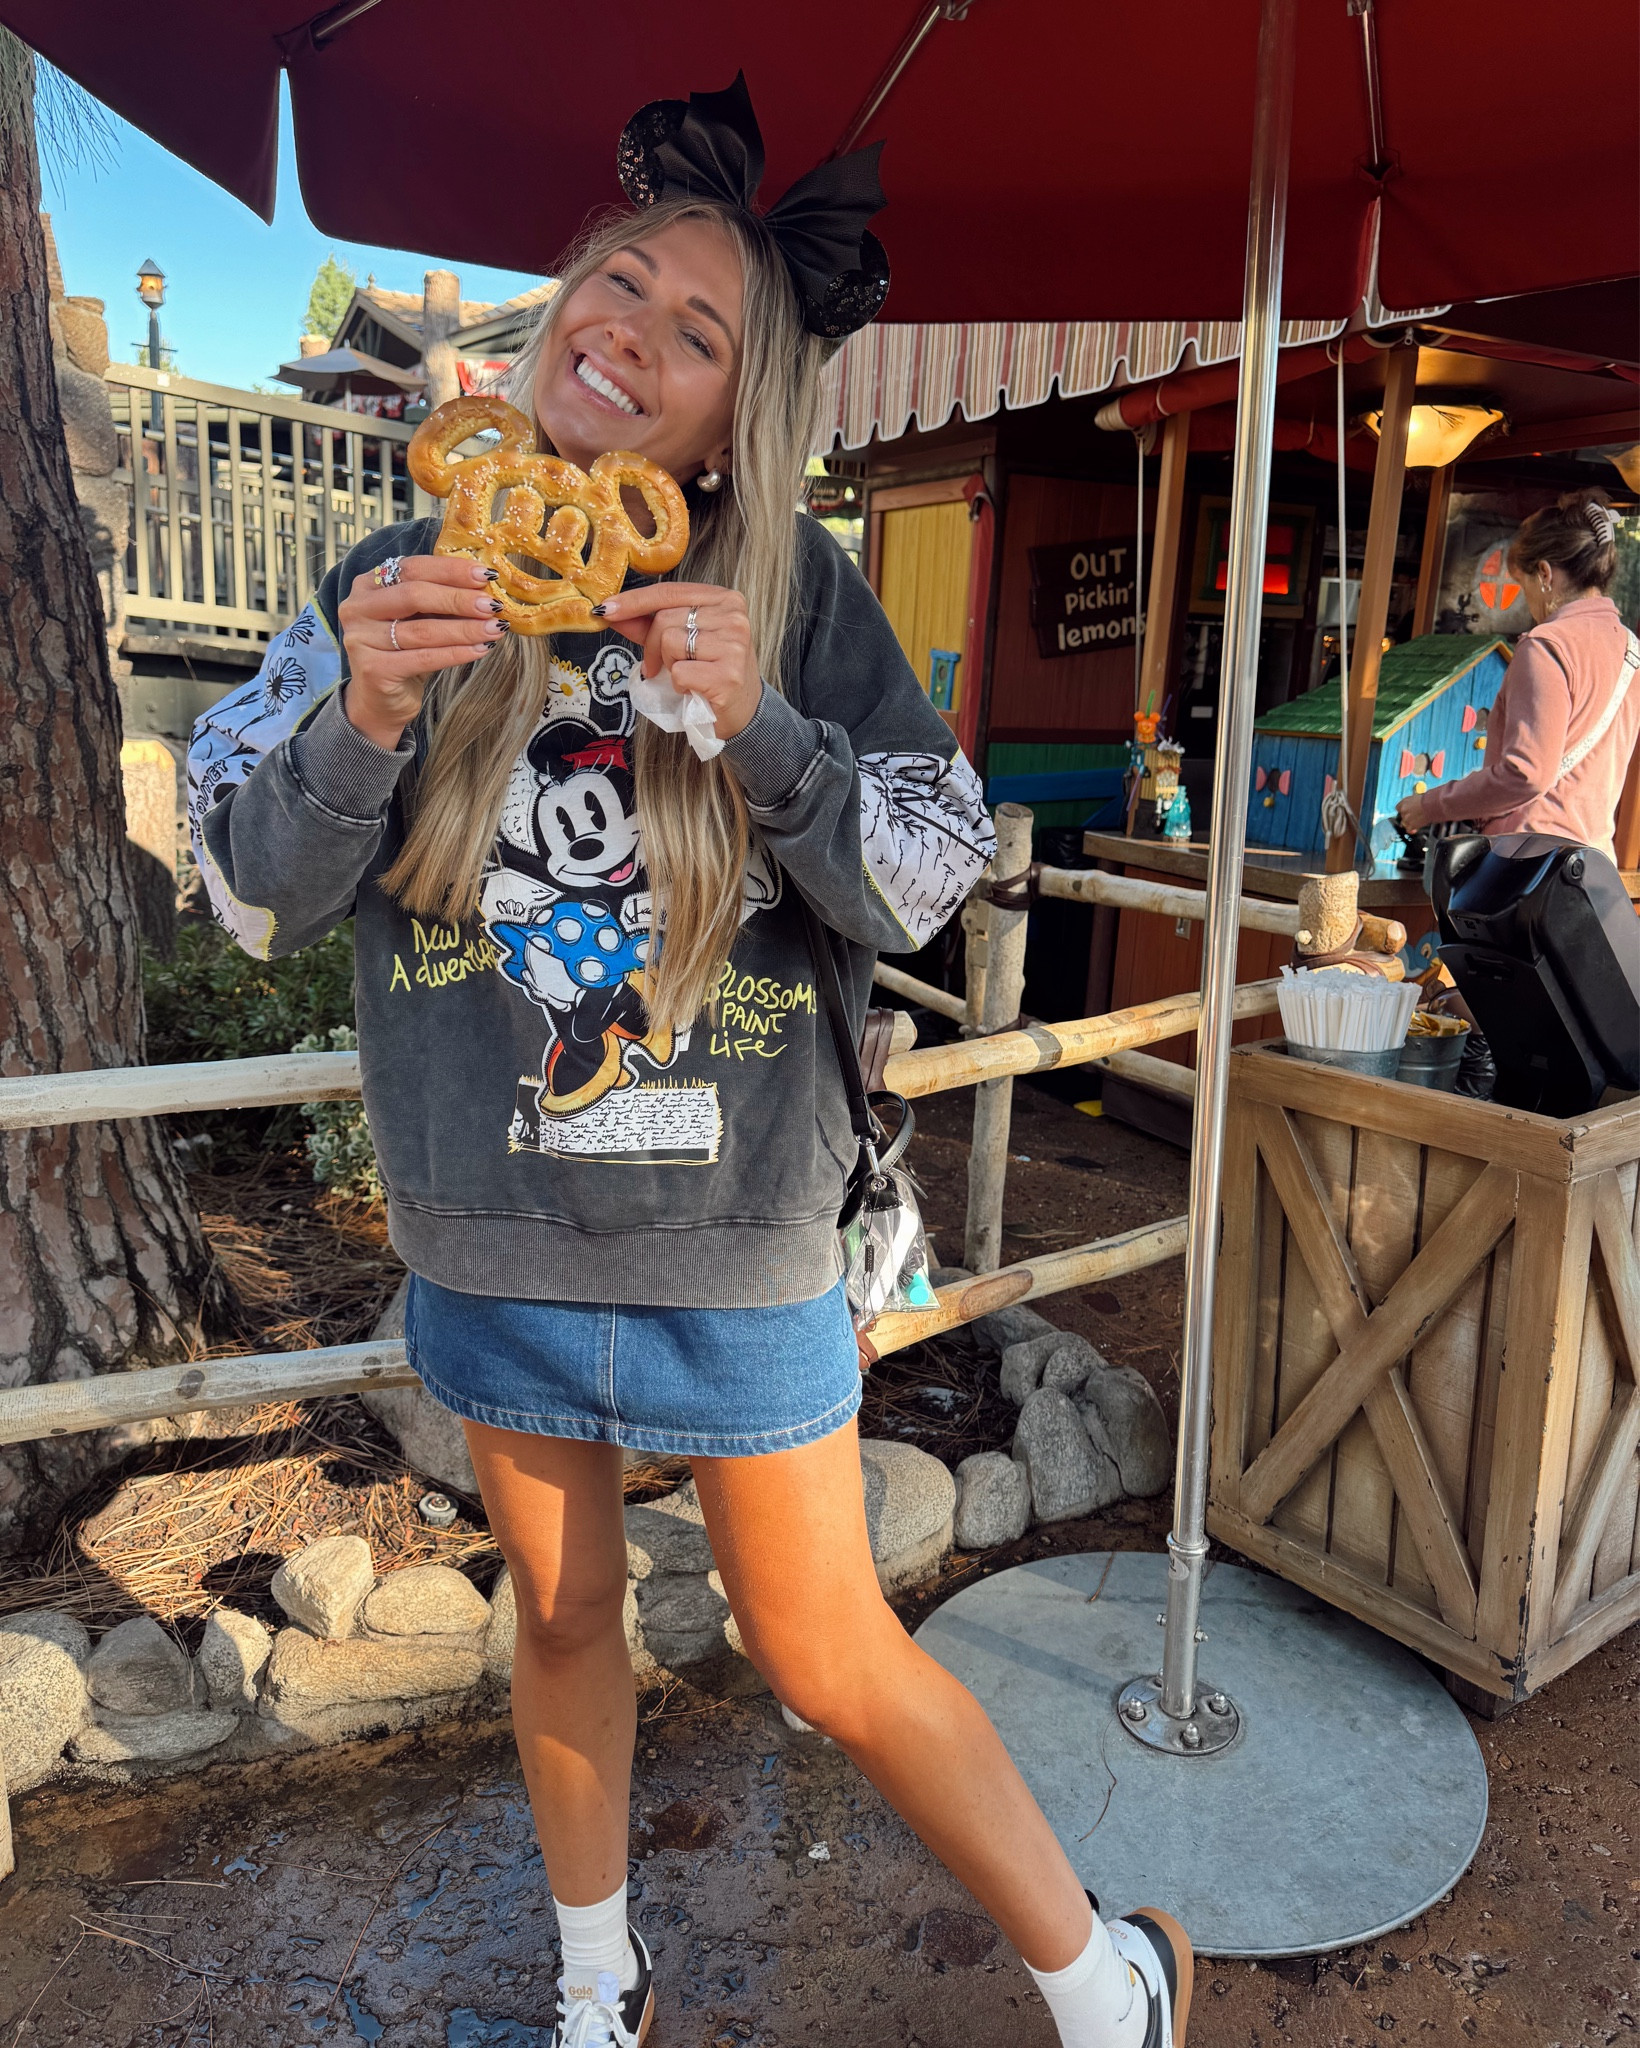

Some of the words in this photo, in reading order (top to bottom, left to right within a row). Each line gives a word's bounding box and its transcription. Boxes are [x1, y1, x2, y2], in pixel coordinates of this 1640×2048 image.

[1070, 548, 1127, 580] OUT
[1065, 581, 1134, 615] pickin'
[411, 918, 460, 954] New
[722, 1002, 787, 1035] PAINT
